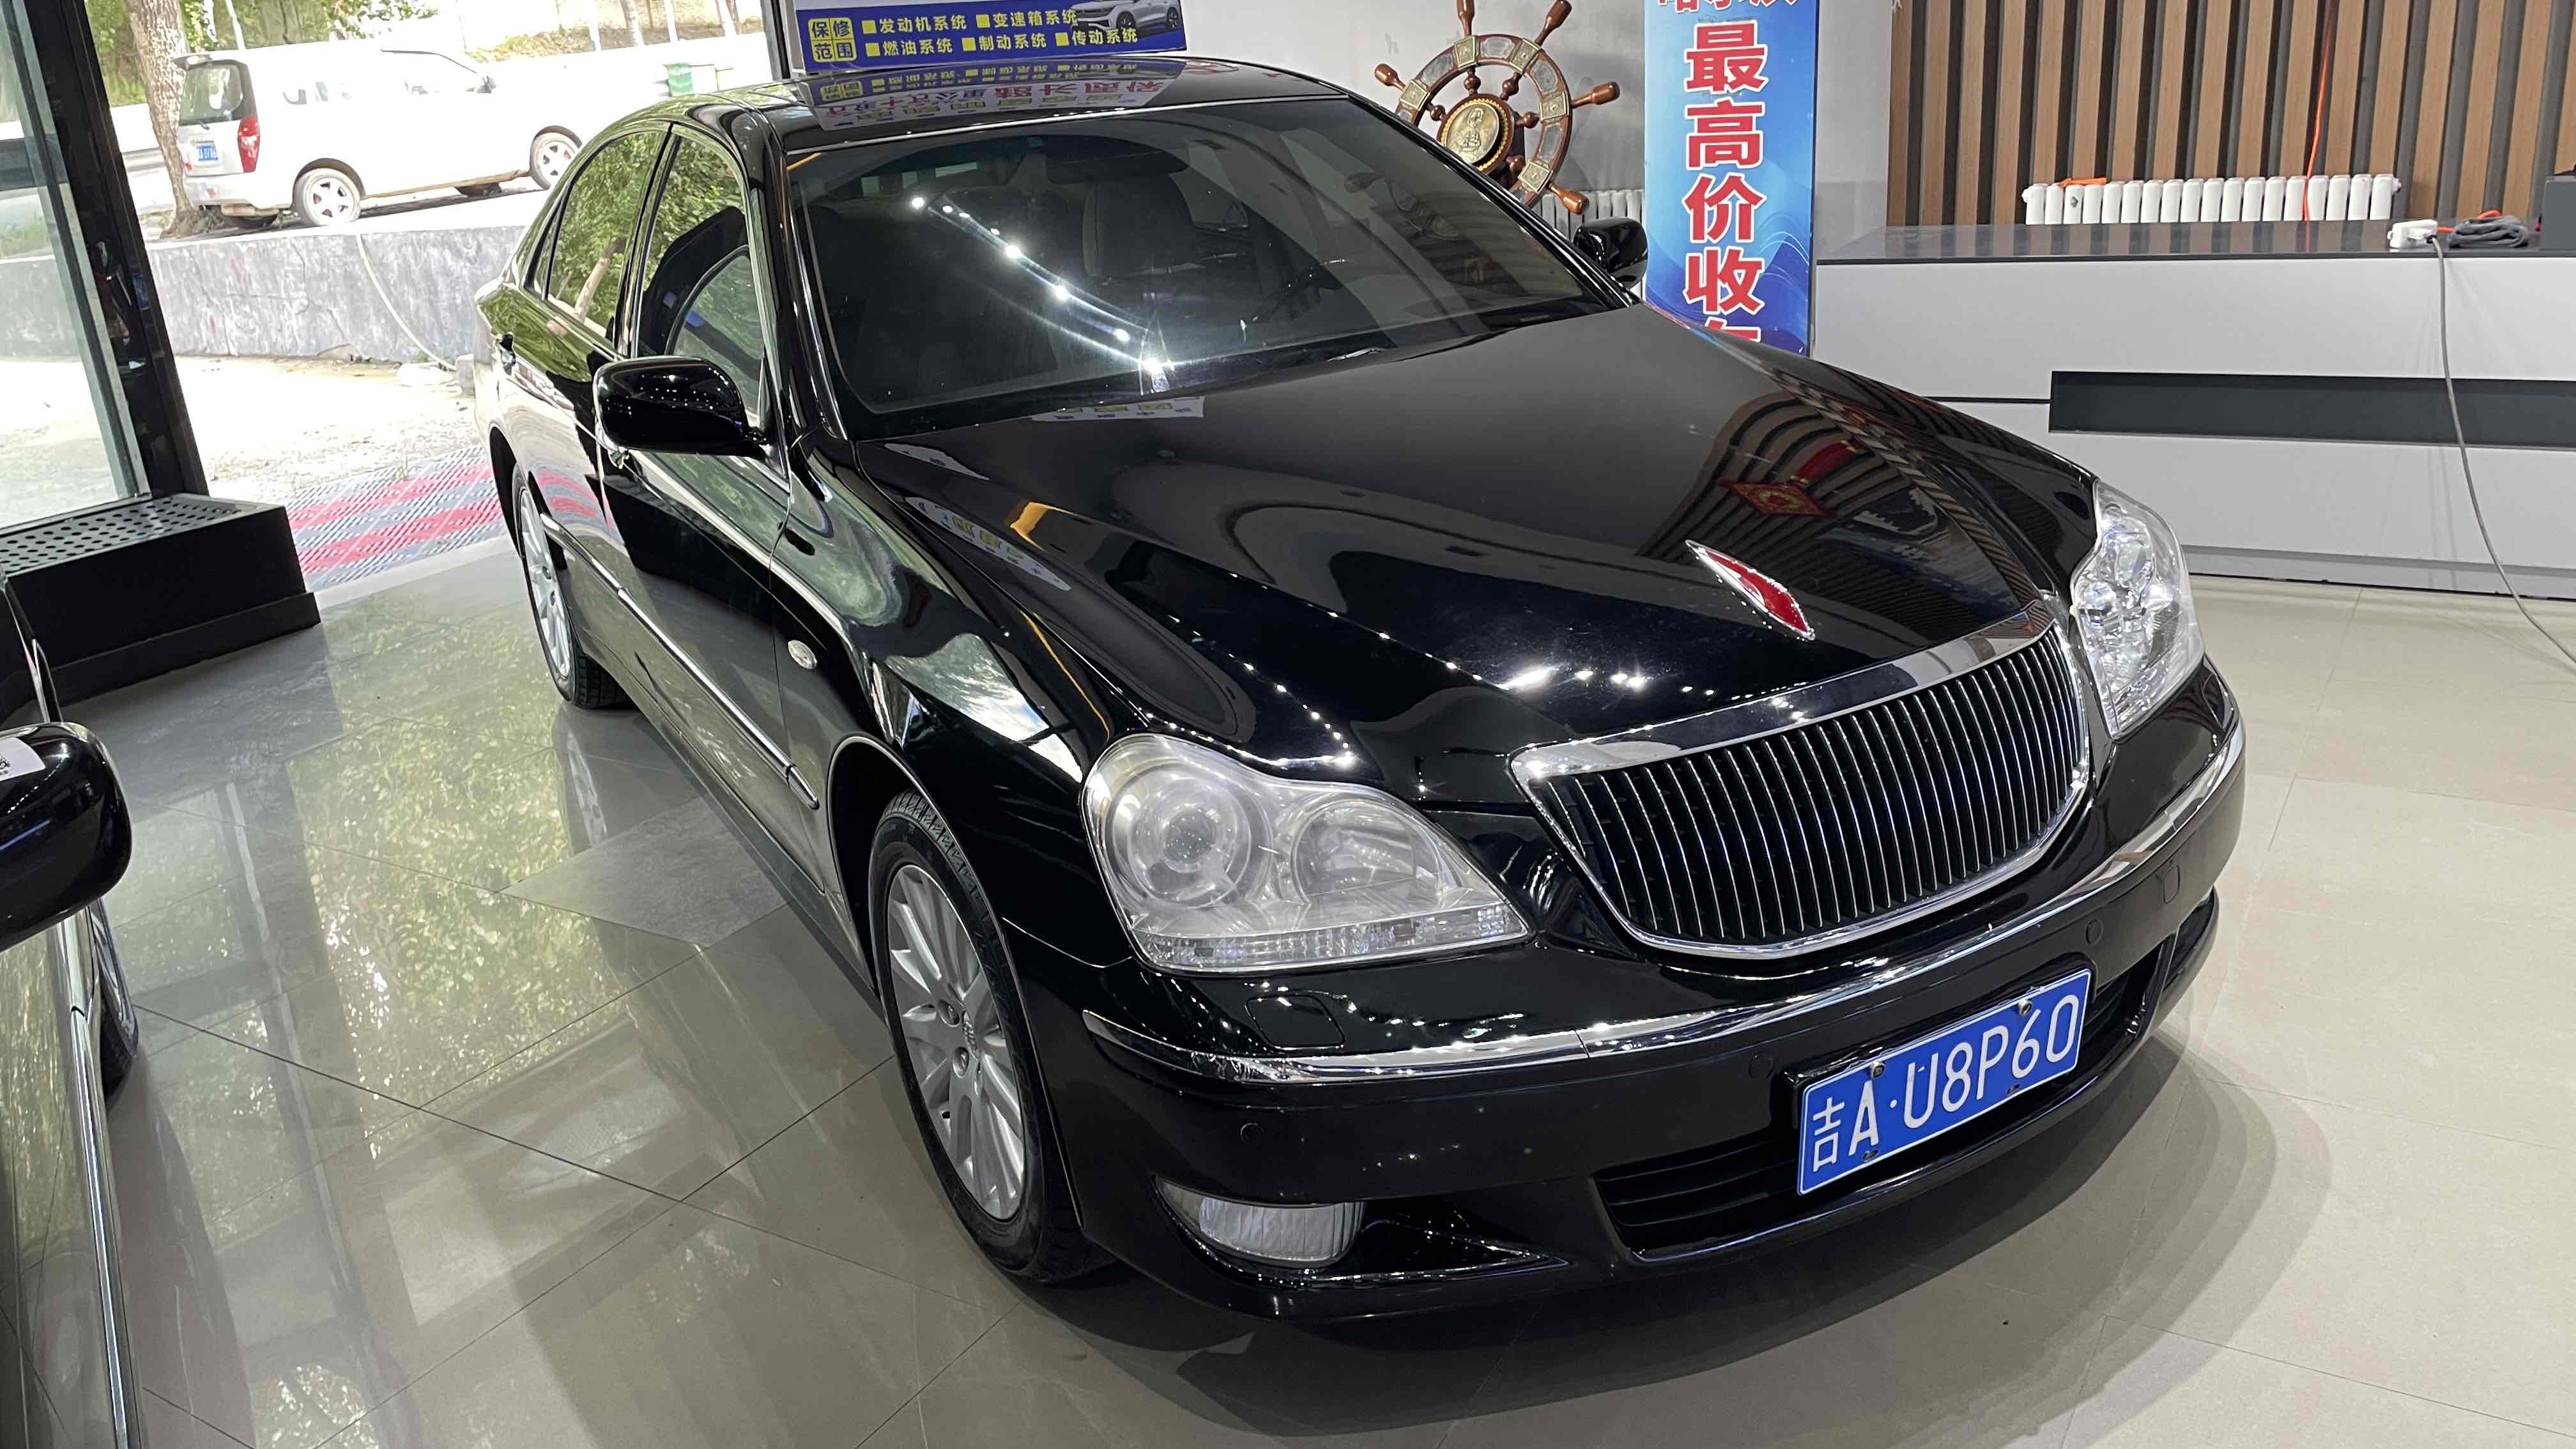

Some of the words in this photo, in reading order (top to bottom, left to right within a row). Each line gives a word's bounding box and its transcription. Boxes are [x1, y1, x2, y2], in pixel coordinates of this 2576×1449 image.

[811, 20, 851, 39] 保修
[879, 15, 967, 33] 发动机系统
[992, 9, 1078, 29] 变速箱系统
[815, 42, 855, 60] 范围
[882, 38, 953, 56] 燃油系统
[978, 32, 1047, 52] 制动系统
[1071, 27, 1138, 46] 传动系统
